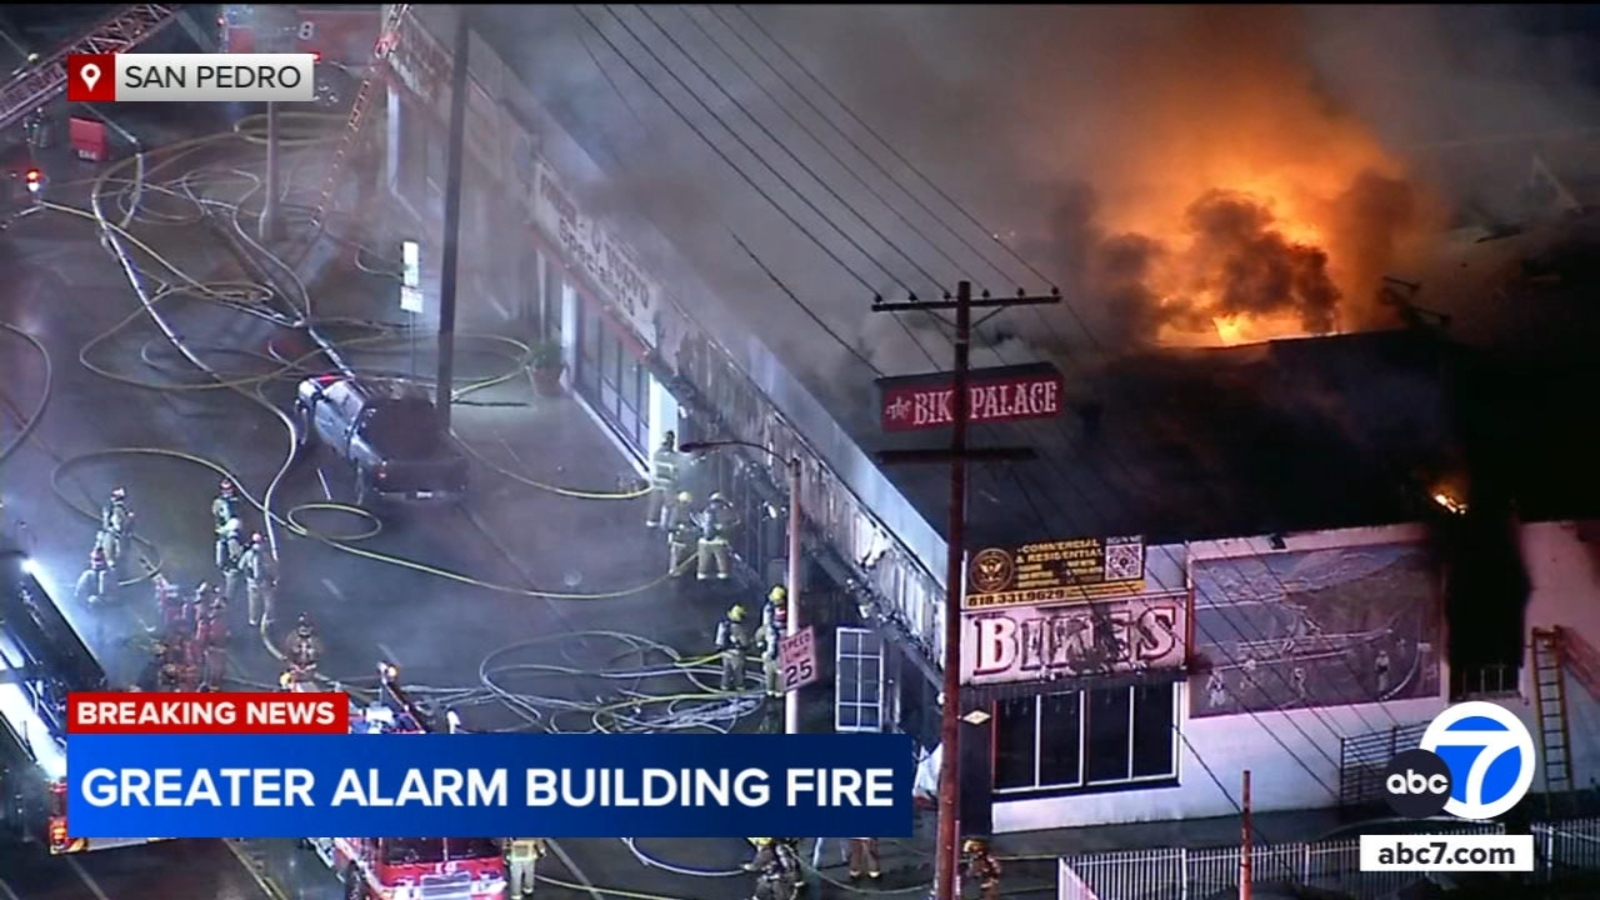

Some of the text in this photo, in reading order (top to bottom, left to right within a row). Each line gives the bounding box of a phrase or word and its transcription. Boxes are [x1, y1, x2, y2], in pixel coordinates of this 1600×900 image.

[914, 390, 954, 425] BIK
[970, 381, 1057, 419] PALACE
[783, 632, 810, 653] SPEED
[785, 658, 812, 687] 25
